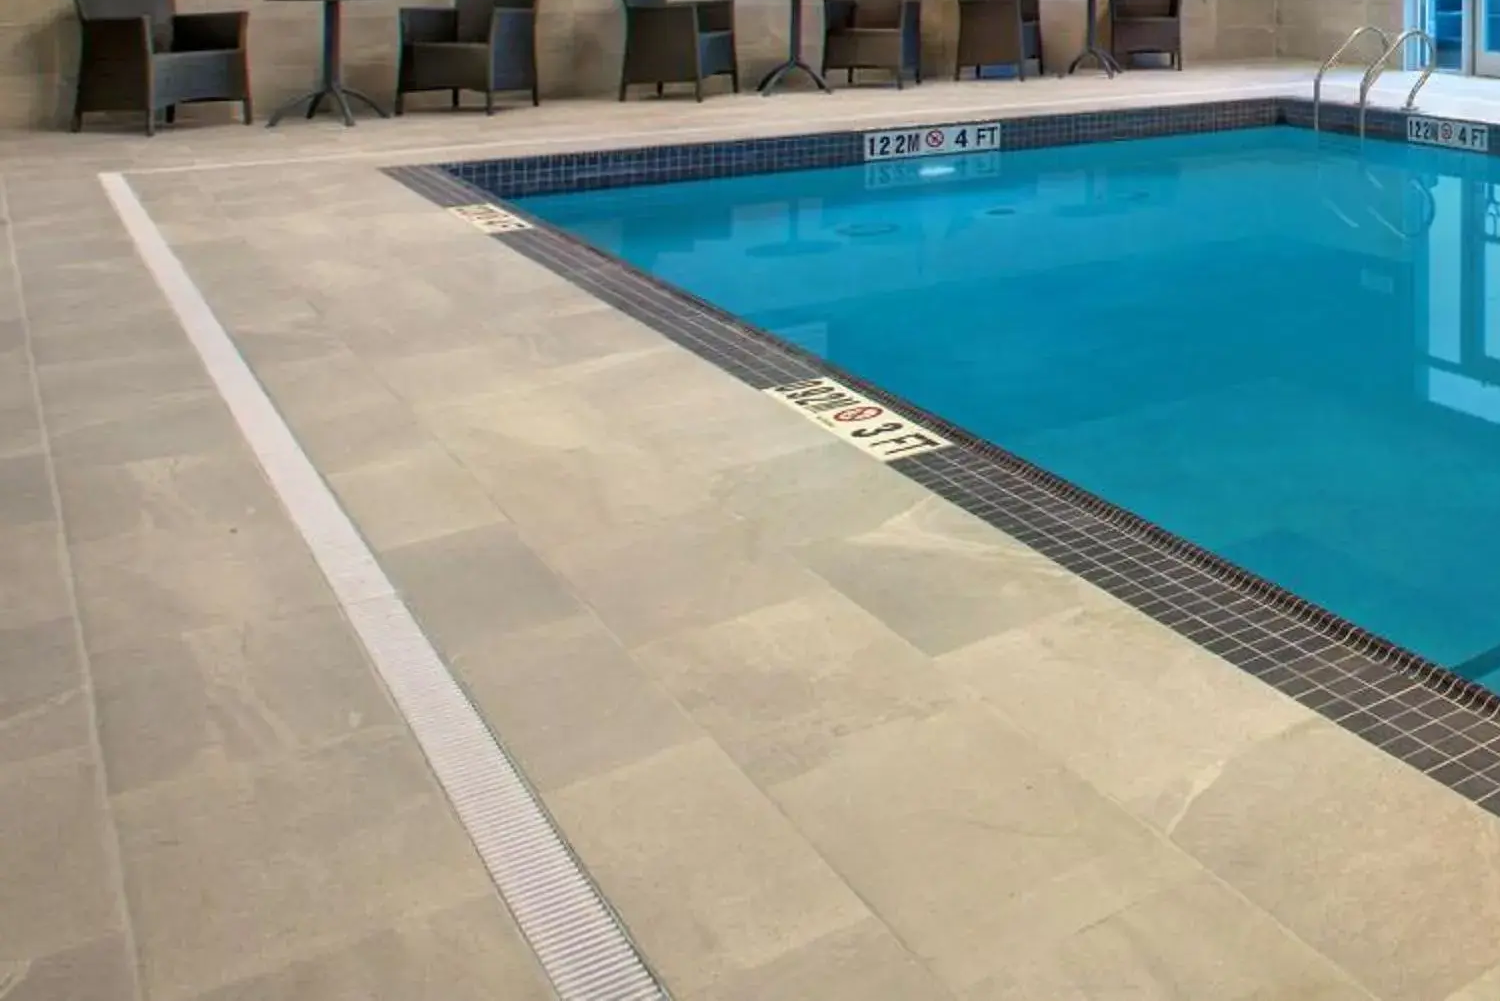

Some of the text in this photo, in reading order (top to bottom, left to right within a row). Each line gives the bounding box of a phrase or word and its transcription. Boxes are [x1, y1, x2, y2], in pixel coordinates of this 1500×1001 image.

[955, 128, 968, 148] 4
[976, 127, 998, 146] FT
[1458, 126, 1467, 145] 4
[1471, 128, 1486, 148] FT
[851, 422, 904, 438] 3
[869, 433, 941, 456] FT
